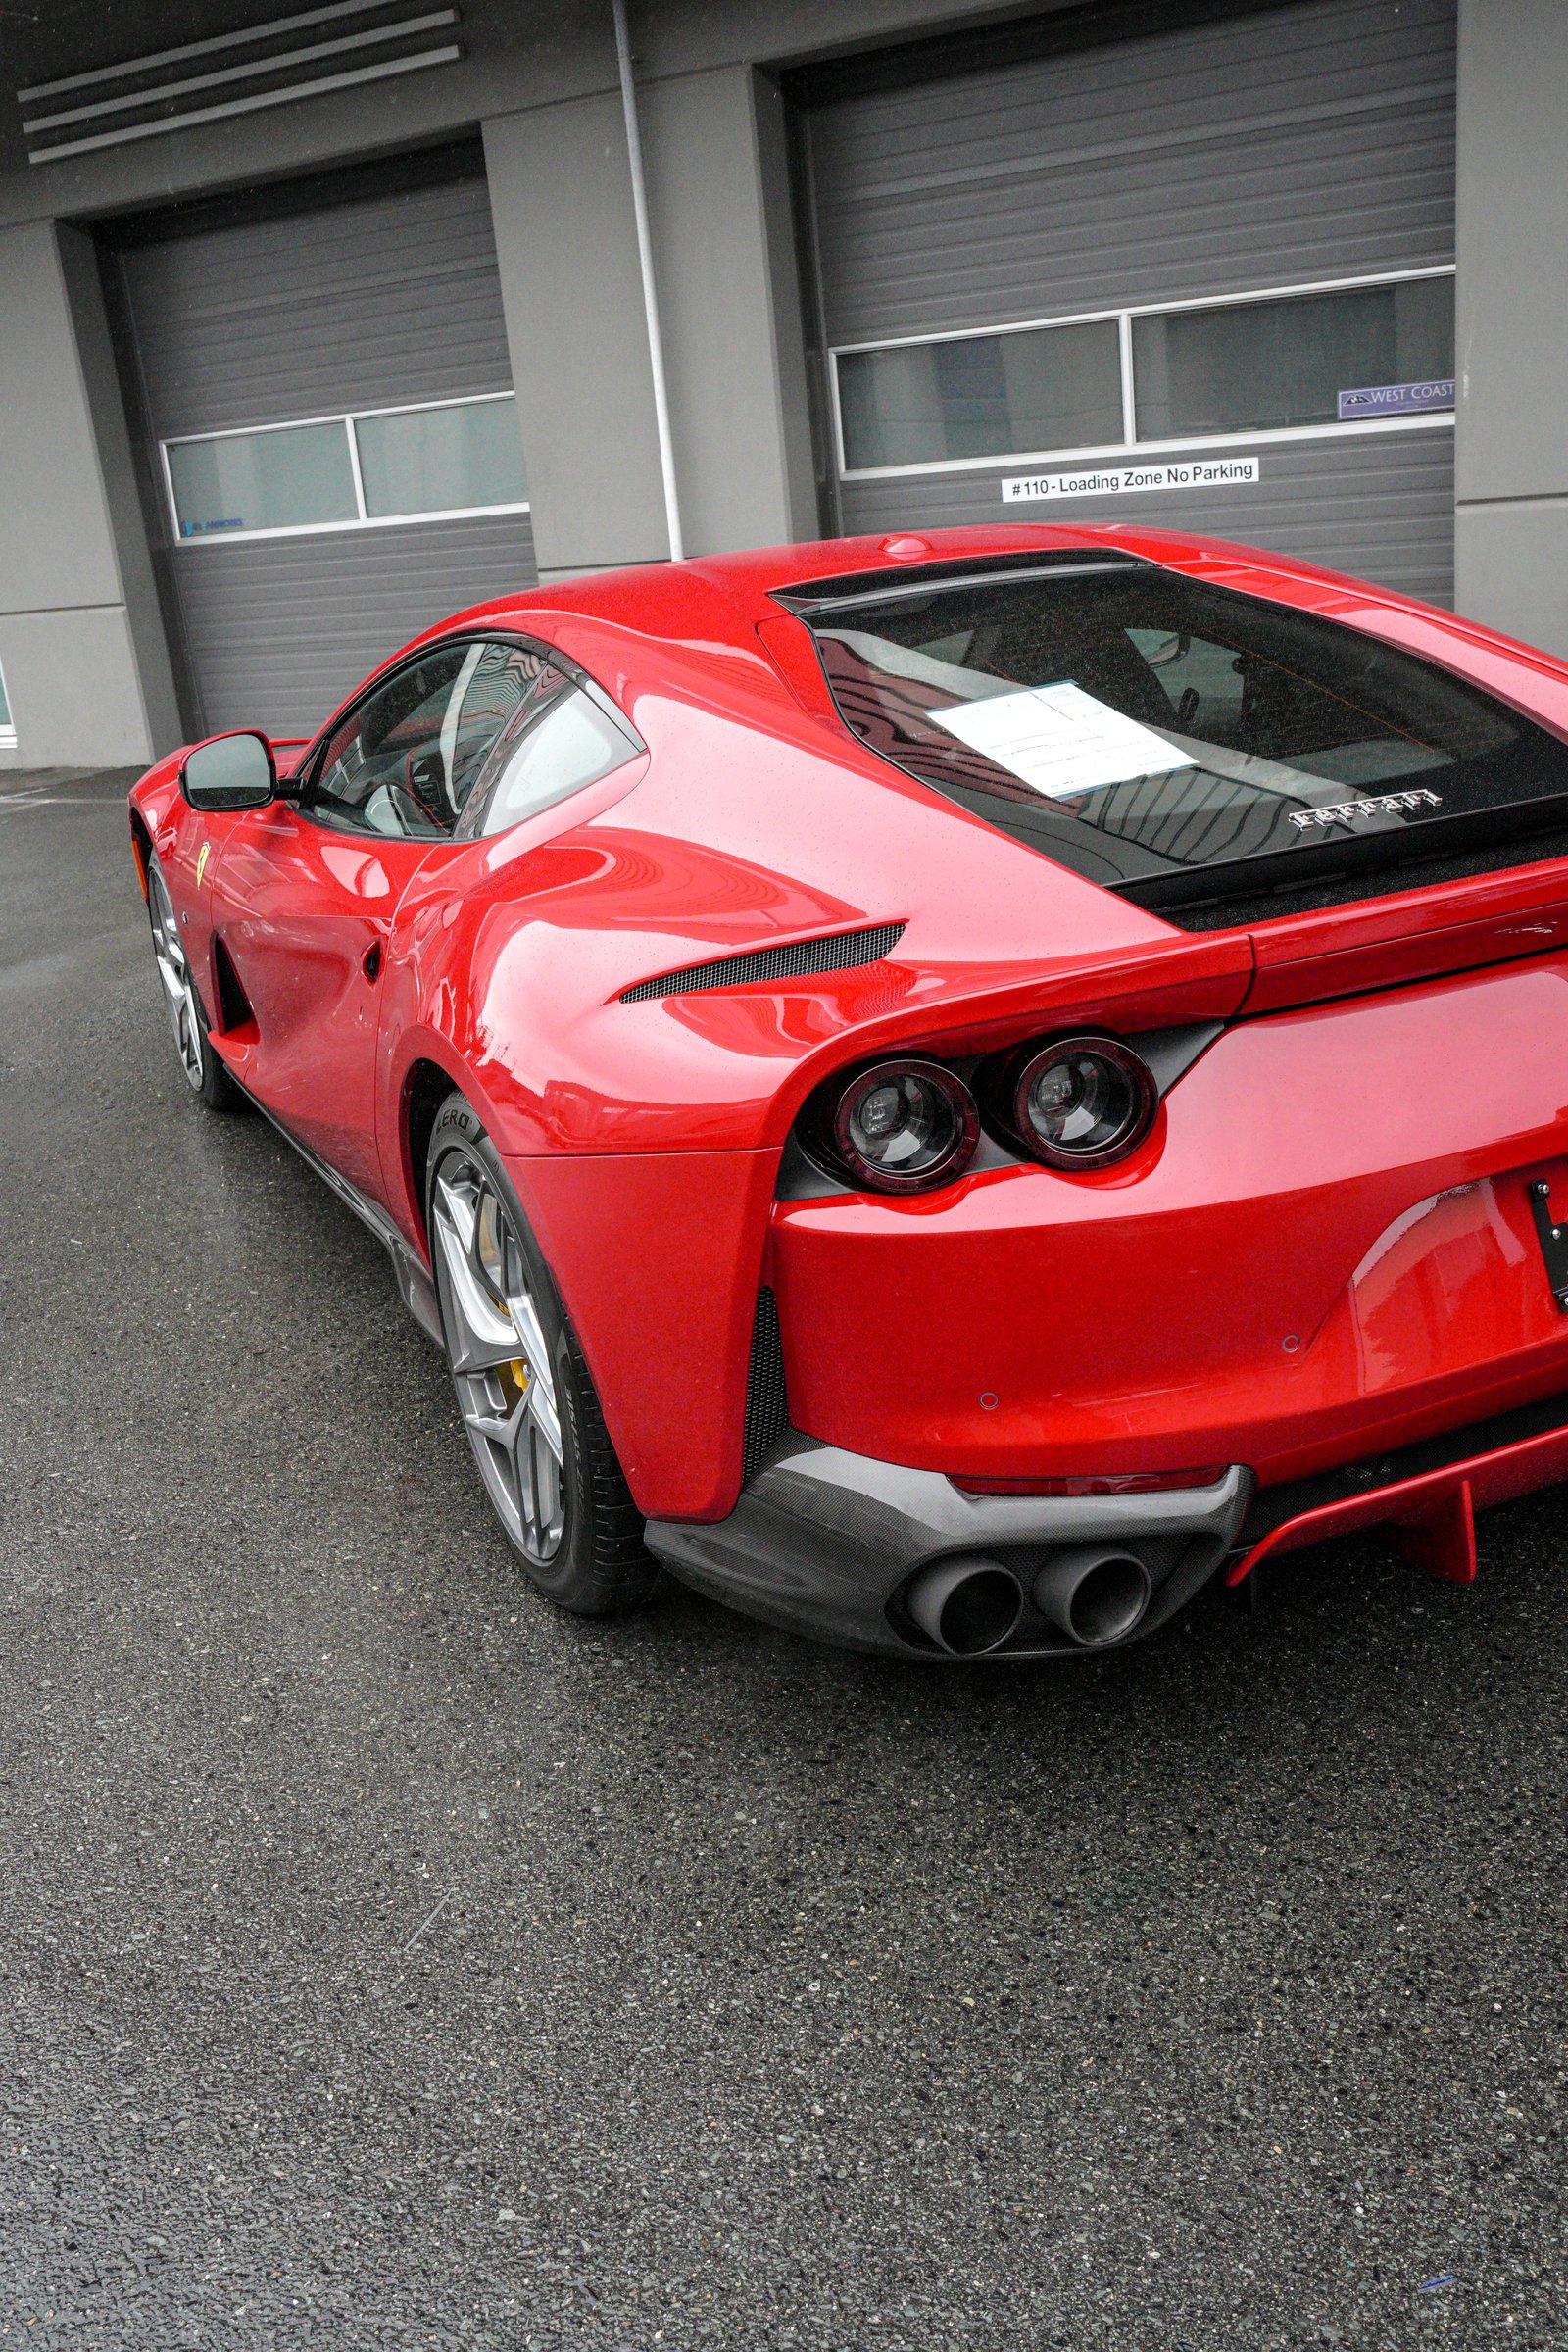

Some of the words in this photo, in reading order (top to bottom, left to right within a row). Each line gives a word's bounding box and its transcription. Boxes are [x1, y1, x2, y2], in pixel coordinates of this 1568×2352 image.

[1371, 389, 1406, 403] WEST
[1411, 383, 1455, 400] COAST
[1059, 475, 1119, 492] Loading
[1124, 472, 1162, 486] Zone
[1167, 468, 1189, 483] No
[1193, 464, 1252, 480] Parking
[1288, 789, 1443, 830] Ferrari
